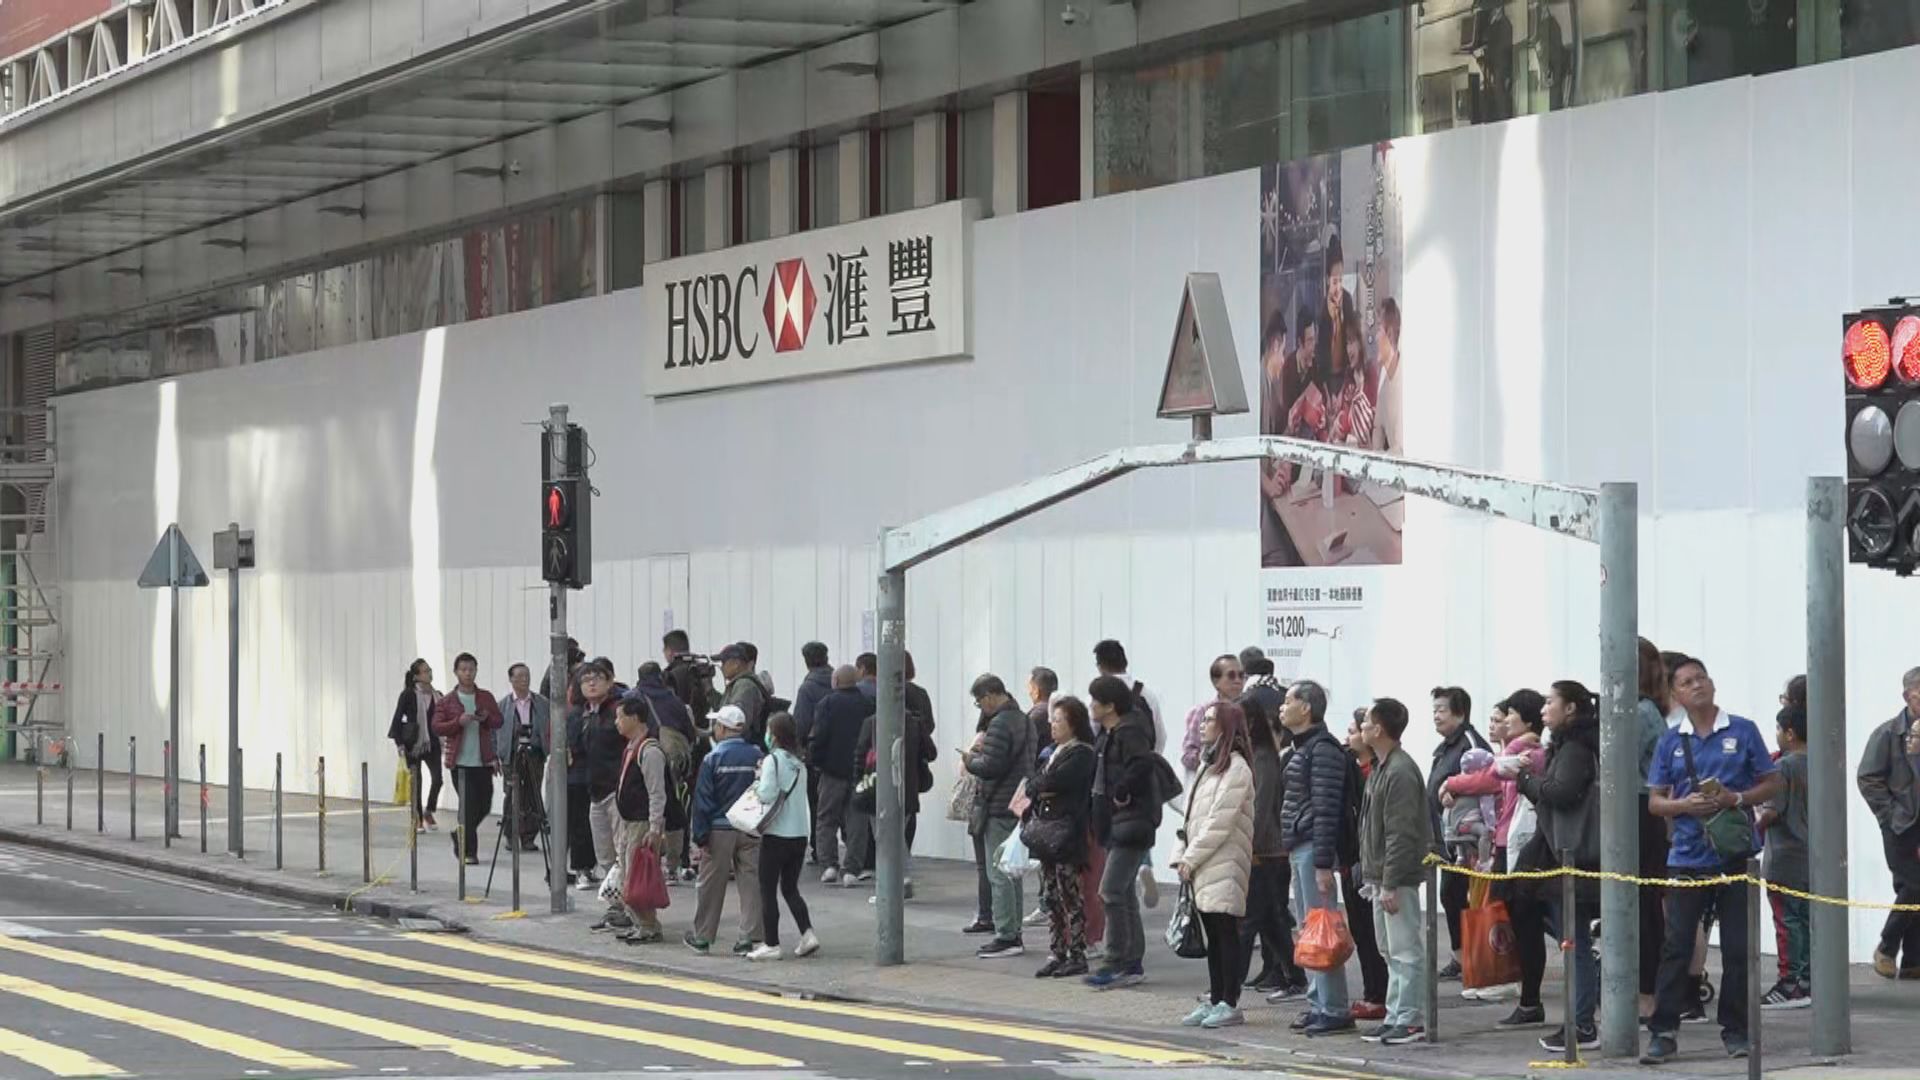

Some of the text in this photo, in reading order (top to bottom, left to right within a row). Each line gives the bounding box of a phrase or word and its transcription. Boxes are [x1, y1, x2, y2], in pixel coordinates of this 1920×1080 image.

[664, 265, 759, 369] HSBC
[823, 235, 935, 345] 滙豐
[1275, 615, 1305, 639] $1,200
